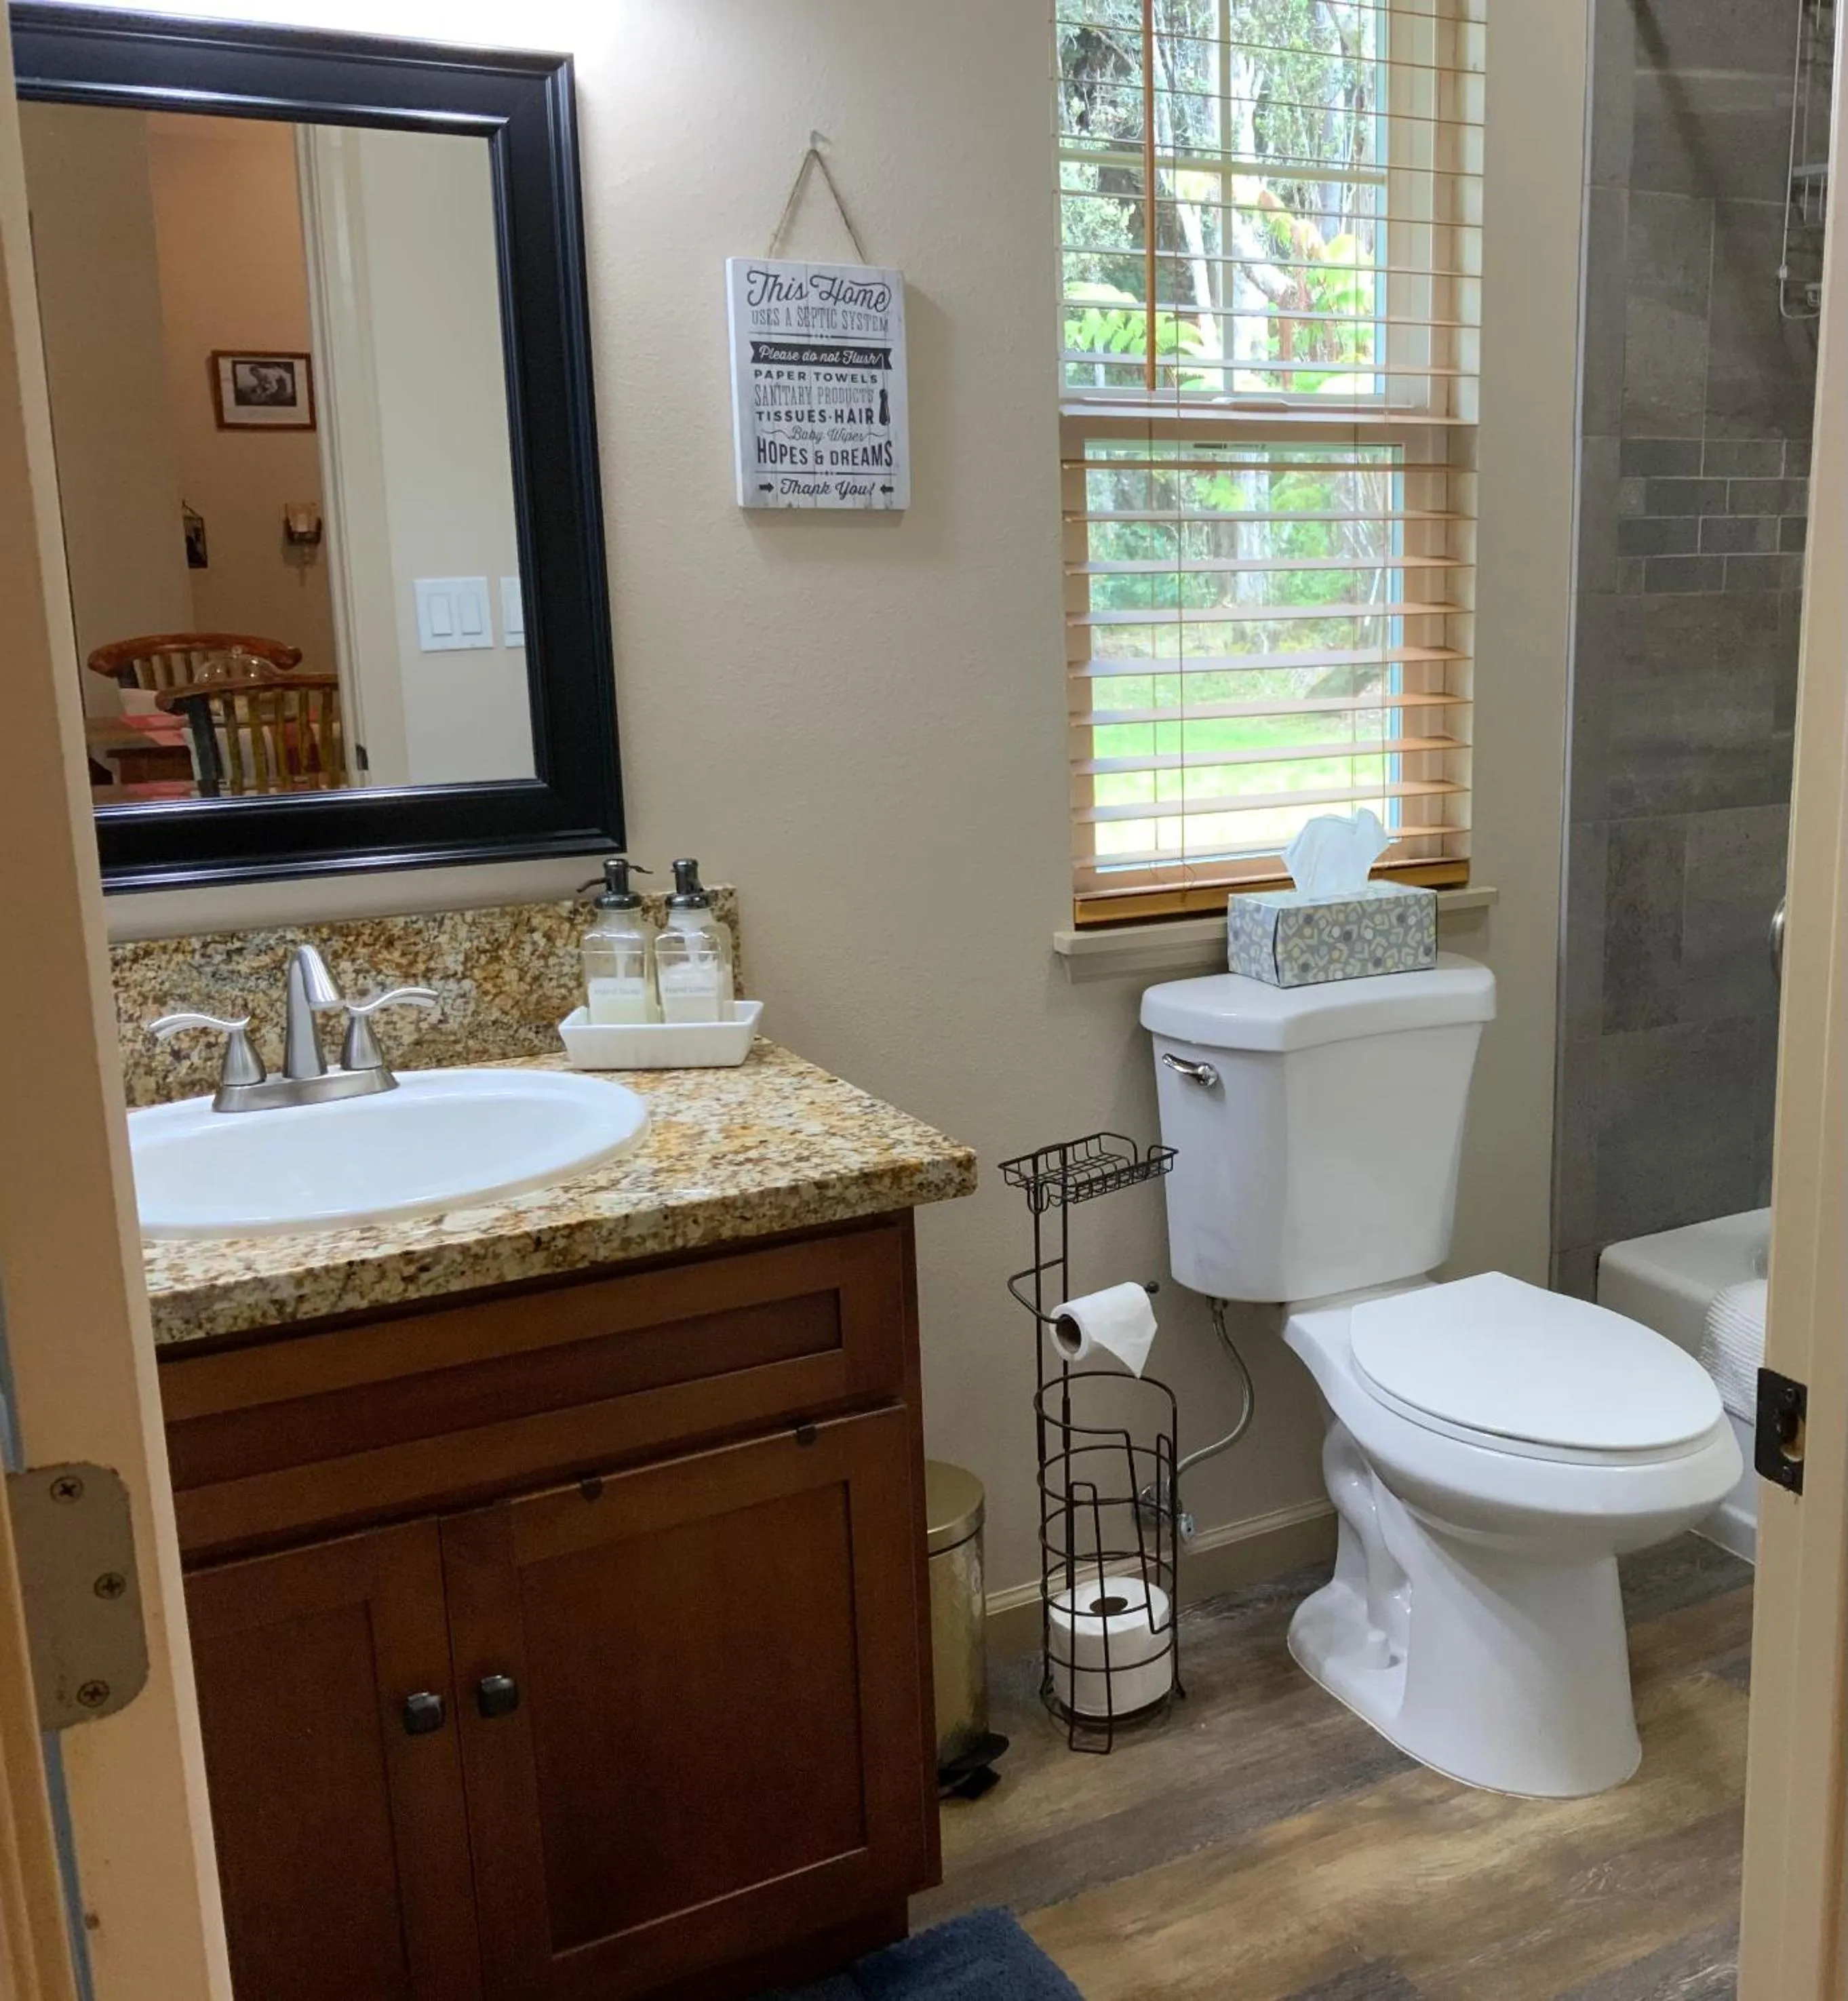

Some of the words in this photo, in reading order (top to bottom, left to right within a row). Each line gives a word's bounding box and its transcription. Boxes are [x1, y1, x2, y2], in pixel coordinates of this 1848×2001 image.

[747, 270, 809, 306] This
[810, 275, 892, 313] Home
[751, 308, 780, 326] USES
[785, 307, 792, 327] A
[797, 306, 838, 330] SEPTIC
[842, 310, 889, 332] SYSTEM
[759, 344, 801, 361] Please
[802, 349, 817, 362] do
[819, 350, 840, 363] not
[754, 369, 806, 381] PAPER
[814, 372, 878, 384] TOWELS
[755, 384, 812, 406] SANITARY
[817, 387, 874, 405] PRODUCTS
[791, 425, 823, 445] Baby
[827, 427, 865, 444] Wipes
[757, 436, 808, 465] HOPES
[814, 450, 824, 465] &
[830, 440, 893, 467] DREAMS
[780, 478, 831, 496] Thank
[835, 480, 876, 500] You!
